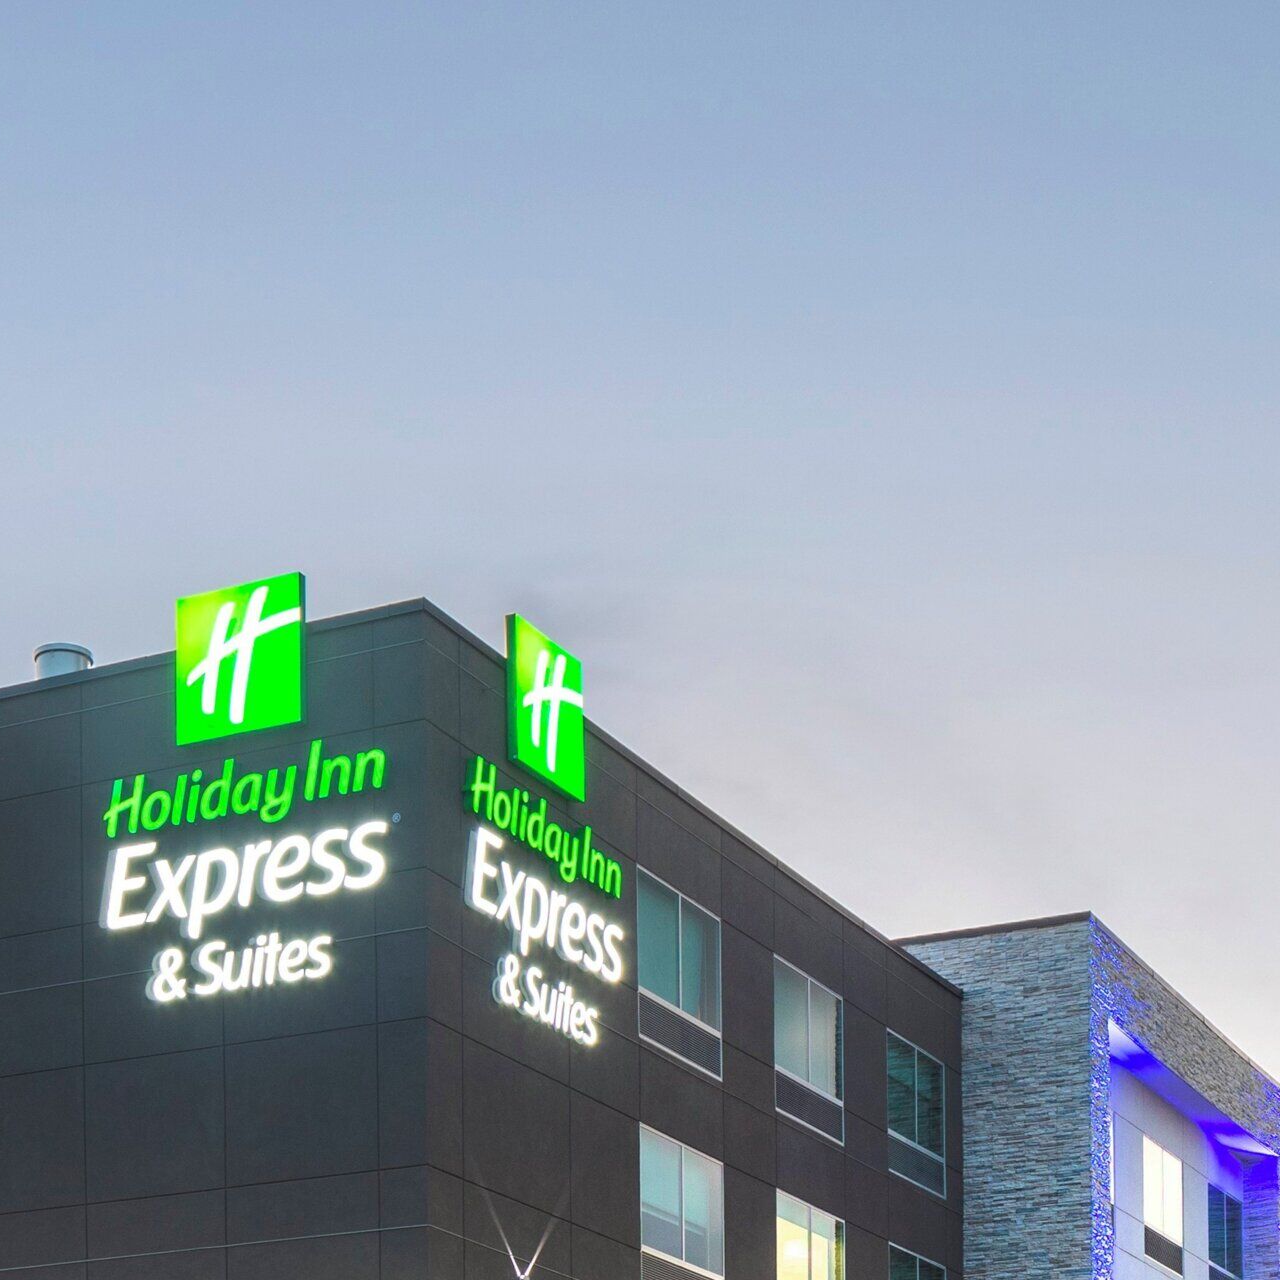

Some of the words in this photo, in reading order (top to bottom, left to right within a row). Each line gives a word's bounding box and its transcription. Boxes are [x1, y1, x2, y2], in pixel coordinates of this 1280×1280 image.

[186, 585, 301, 725] H
[523, 650, 583, 772] H
[103, 758, 297, 838] Holiday
[304, 739, 386, 801] Inn
[471, 755, 579, 883] Holiday
[581, 825, 622, 899] Inn
[104, 821, 388, 940] Express
[470, 826, 624, 983] Express
[150, 948, 187, 1002] &
[193, 932, 333, 997] Suites
[496, 953, 520, 1007] &
[523, 966, 599, 1047] Suites
